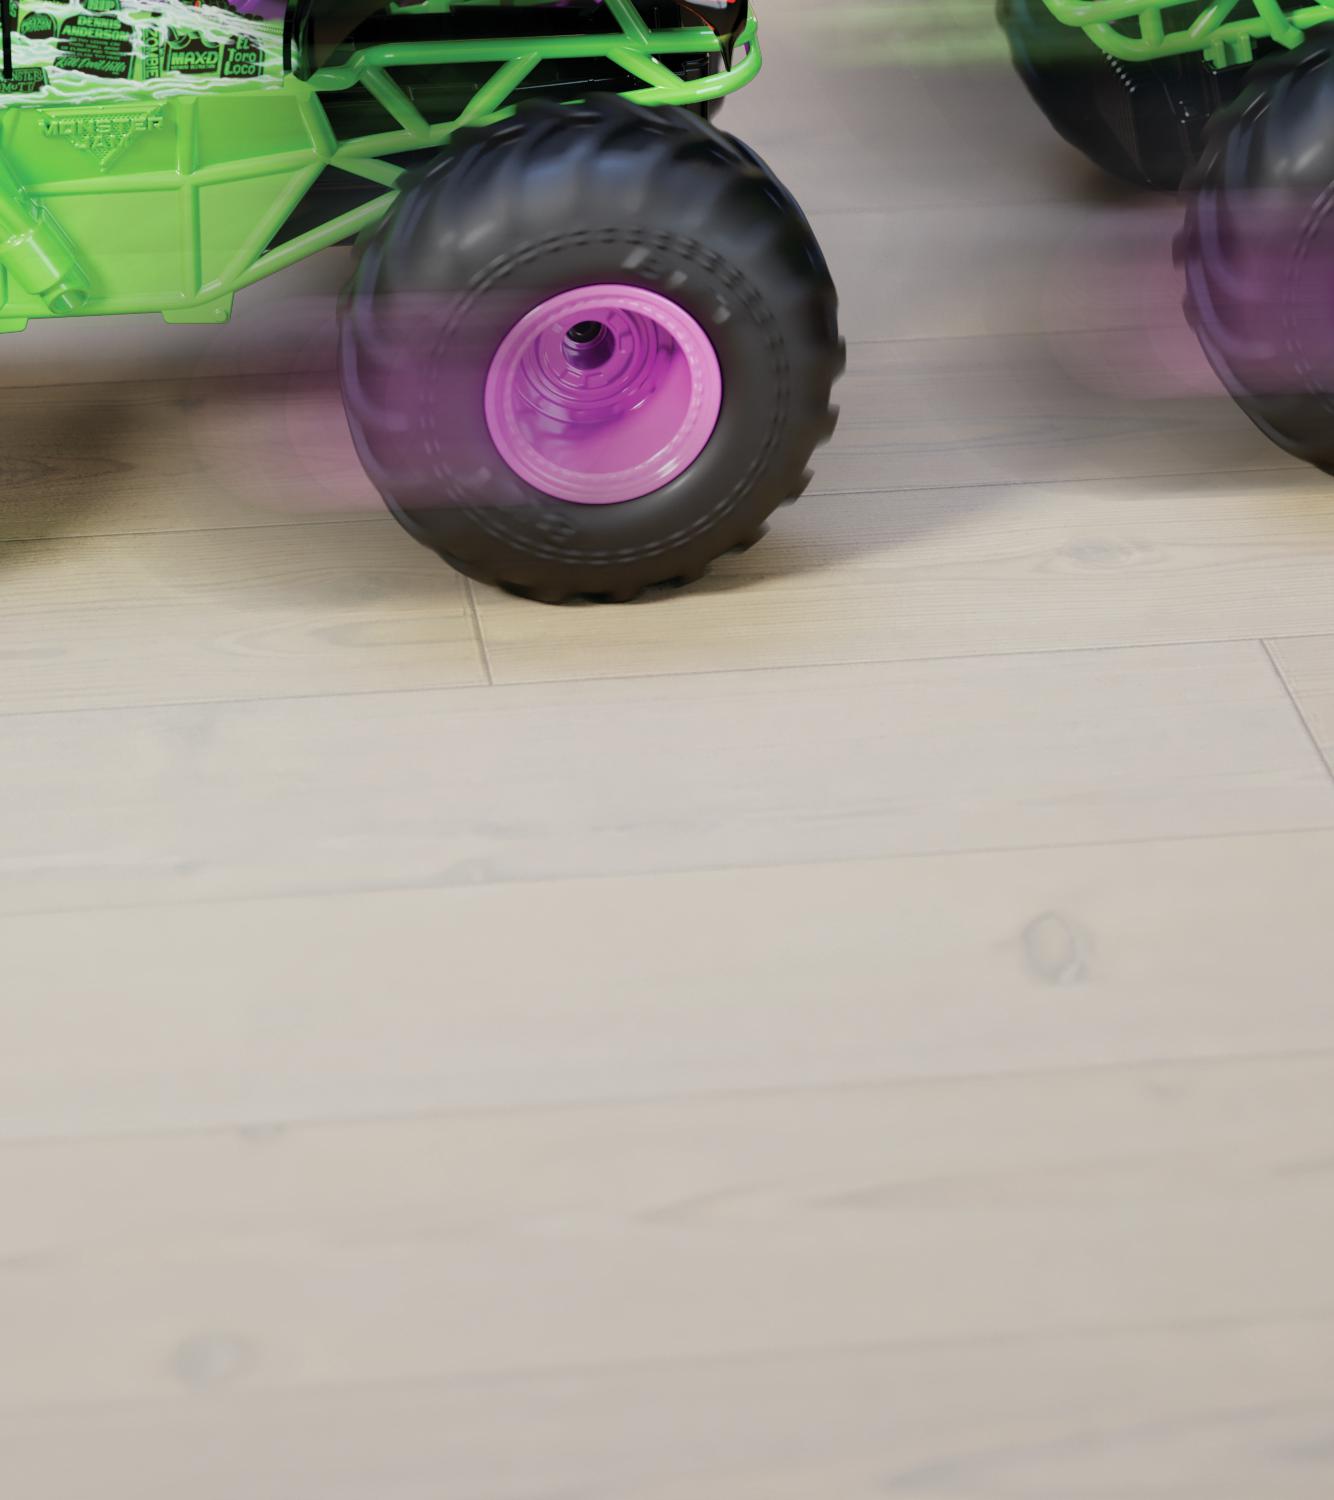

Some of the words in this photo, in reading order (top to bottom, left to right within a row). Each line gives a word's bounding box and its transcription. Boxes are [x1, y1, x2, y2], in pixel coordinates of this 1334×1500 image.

[77, 15, 122, 30] DENNIS
[61, 25, 130, 41] ANDERSON
[236, 37, 250, 50] EL
[145, 28, 161, 78] ZOMBIE
[2, 82, 34, 93] MUTT
[38, 116, 164, 136] MONSTER
[74, 133, 129, 149] JAM
